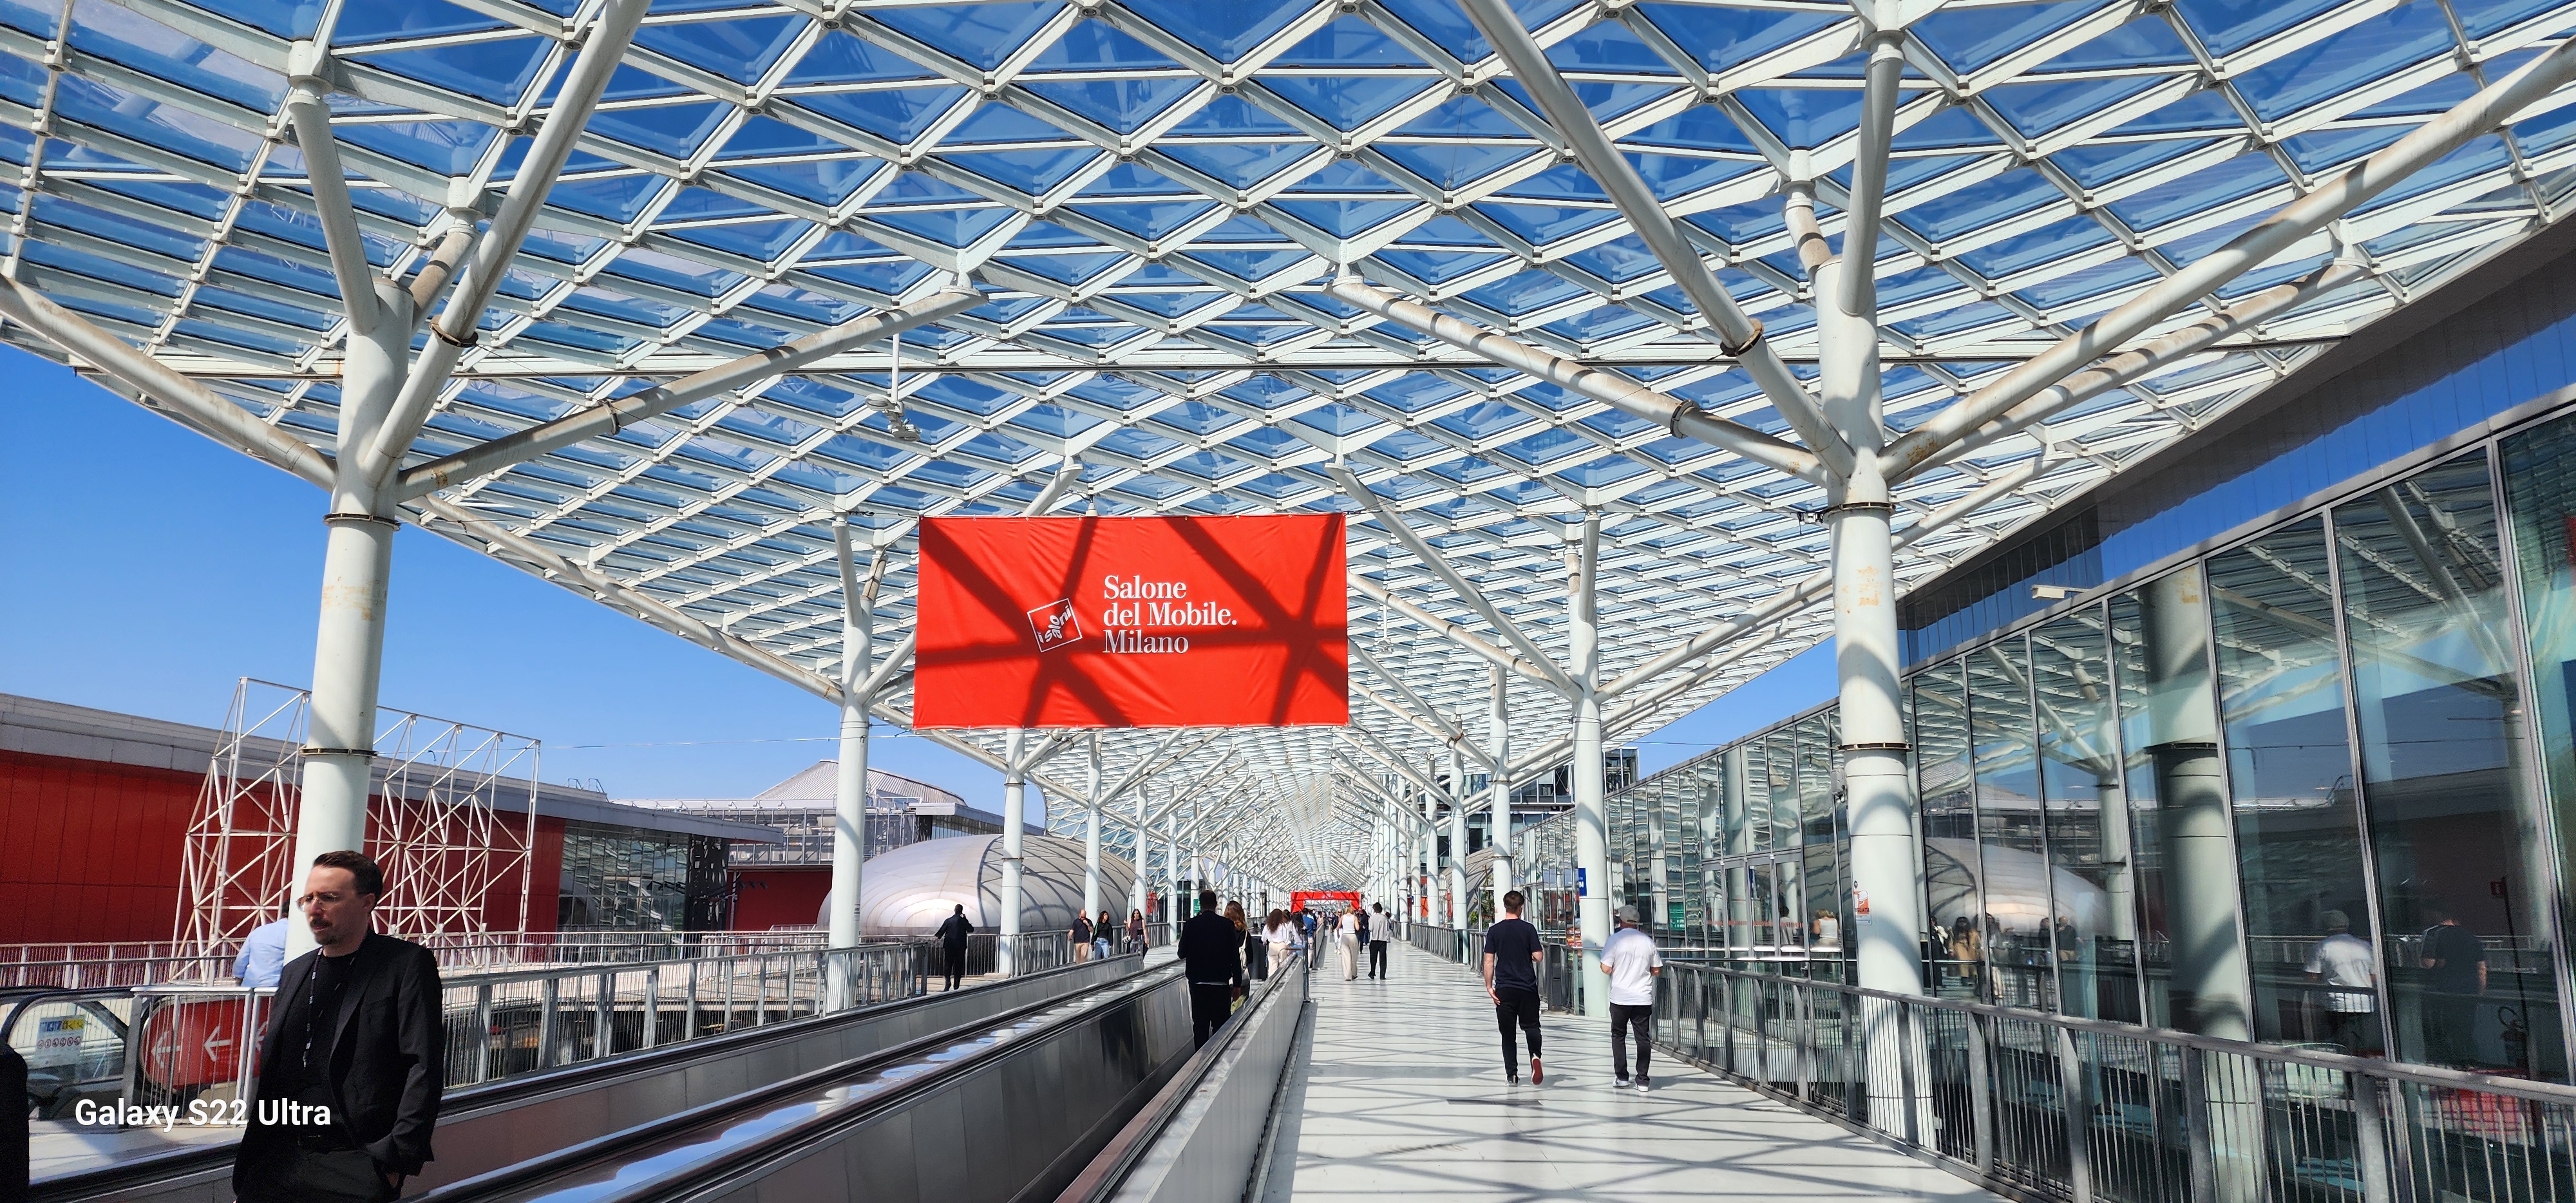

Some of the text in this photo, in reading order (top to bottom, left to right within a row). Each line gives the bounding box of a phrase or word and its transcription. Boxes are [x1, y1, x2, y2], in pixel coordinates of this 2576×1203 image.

[1104, 575, 1186, 599] Salone
[1103, 602, 1237, 626] del Mobile.
[1103, 629, 1189, 653] Milano
